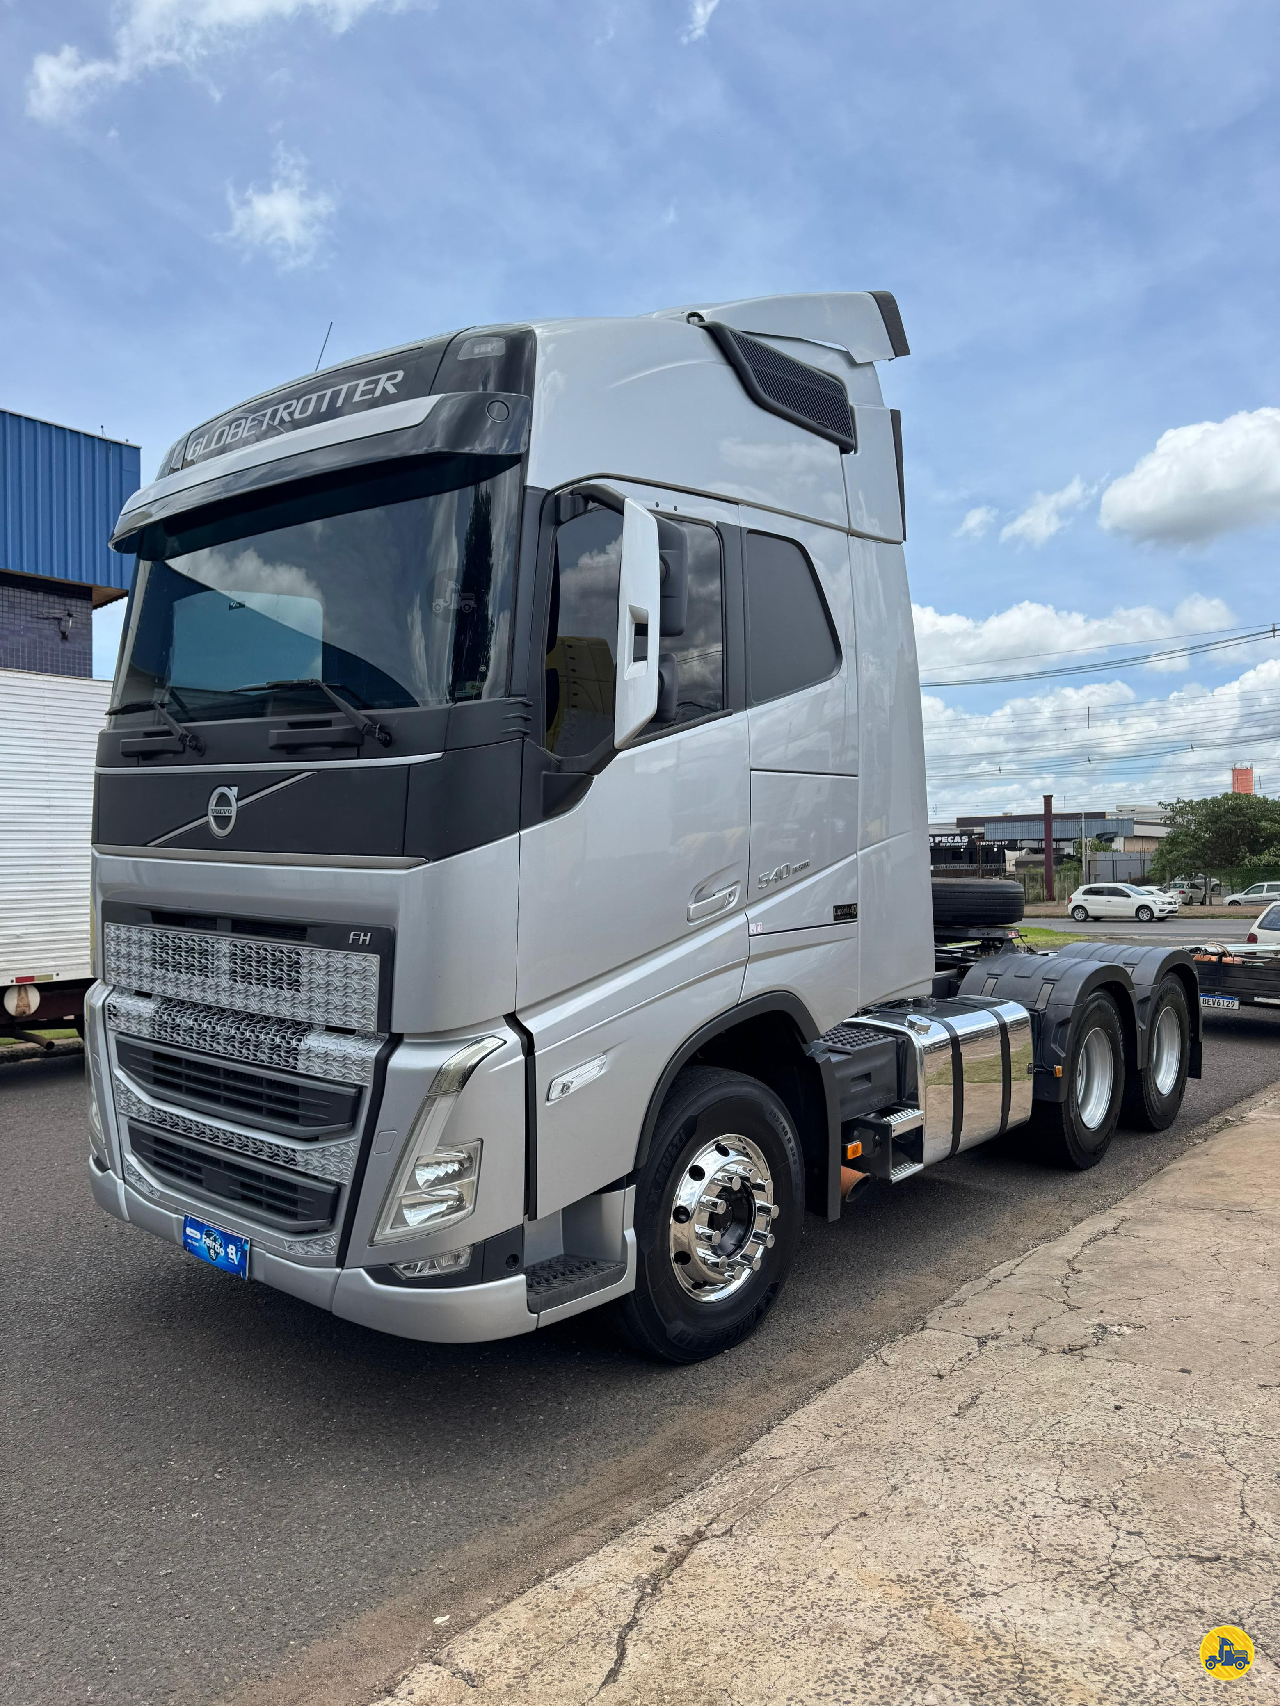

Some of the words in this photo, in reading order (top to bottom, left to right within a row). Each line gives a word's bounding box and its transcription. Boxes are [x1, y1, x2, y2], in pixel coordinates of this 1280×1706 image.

[186, 369, 405, 460] GLOBETROTTER
[758, 862, 791, 890] 540
[348, 931, 372, 945] FH
